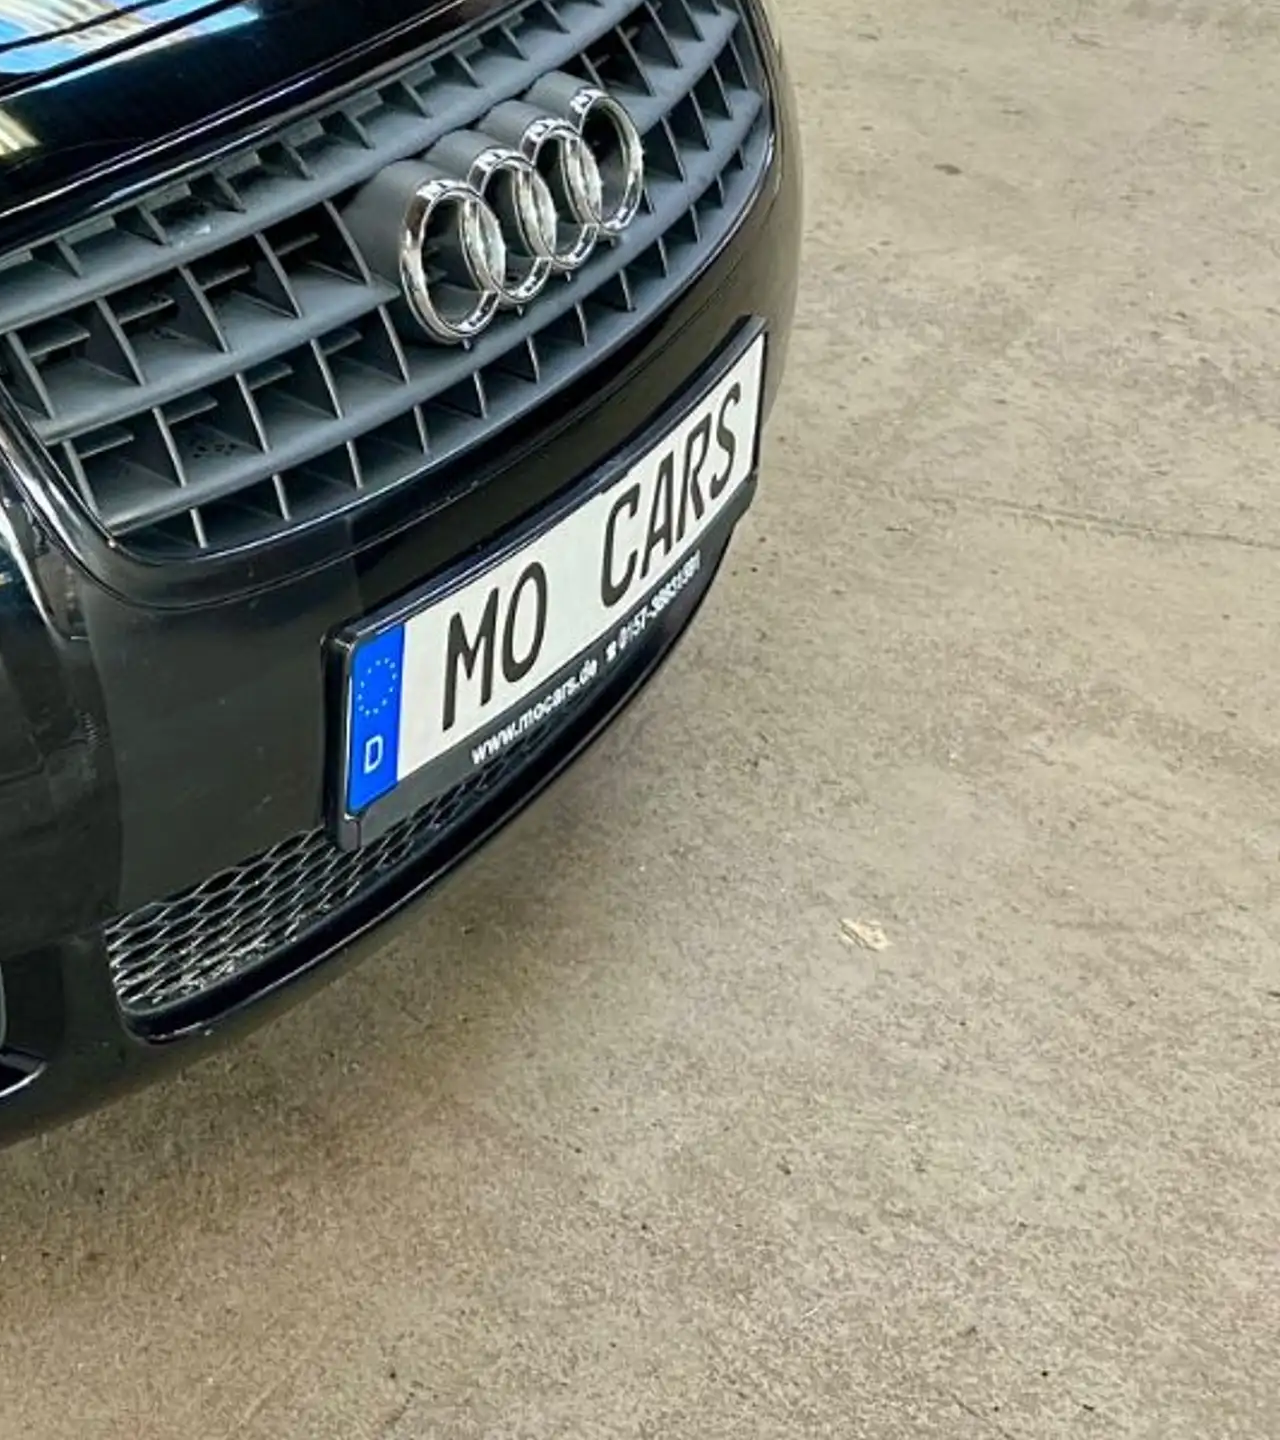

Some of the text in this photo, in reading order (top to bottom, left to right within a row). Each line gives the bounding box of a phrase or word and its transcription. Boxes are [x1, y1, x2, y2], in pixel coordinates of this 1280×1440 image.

[442, 560, 548, 732] MO
[600, 382, 741, 609] CARS
[363, 733, 384, 774] D
